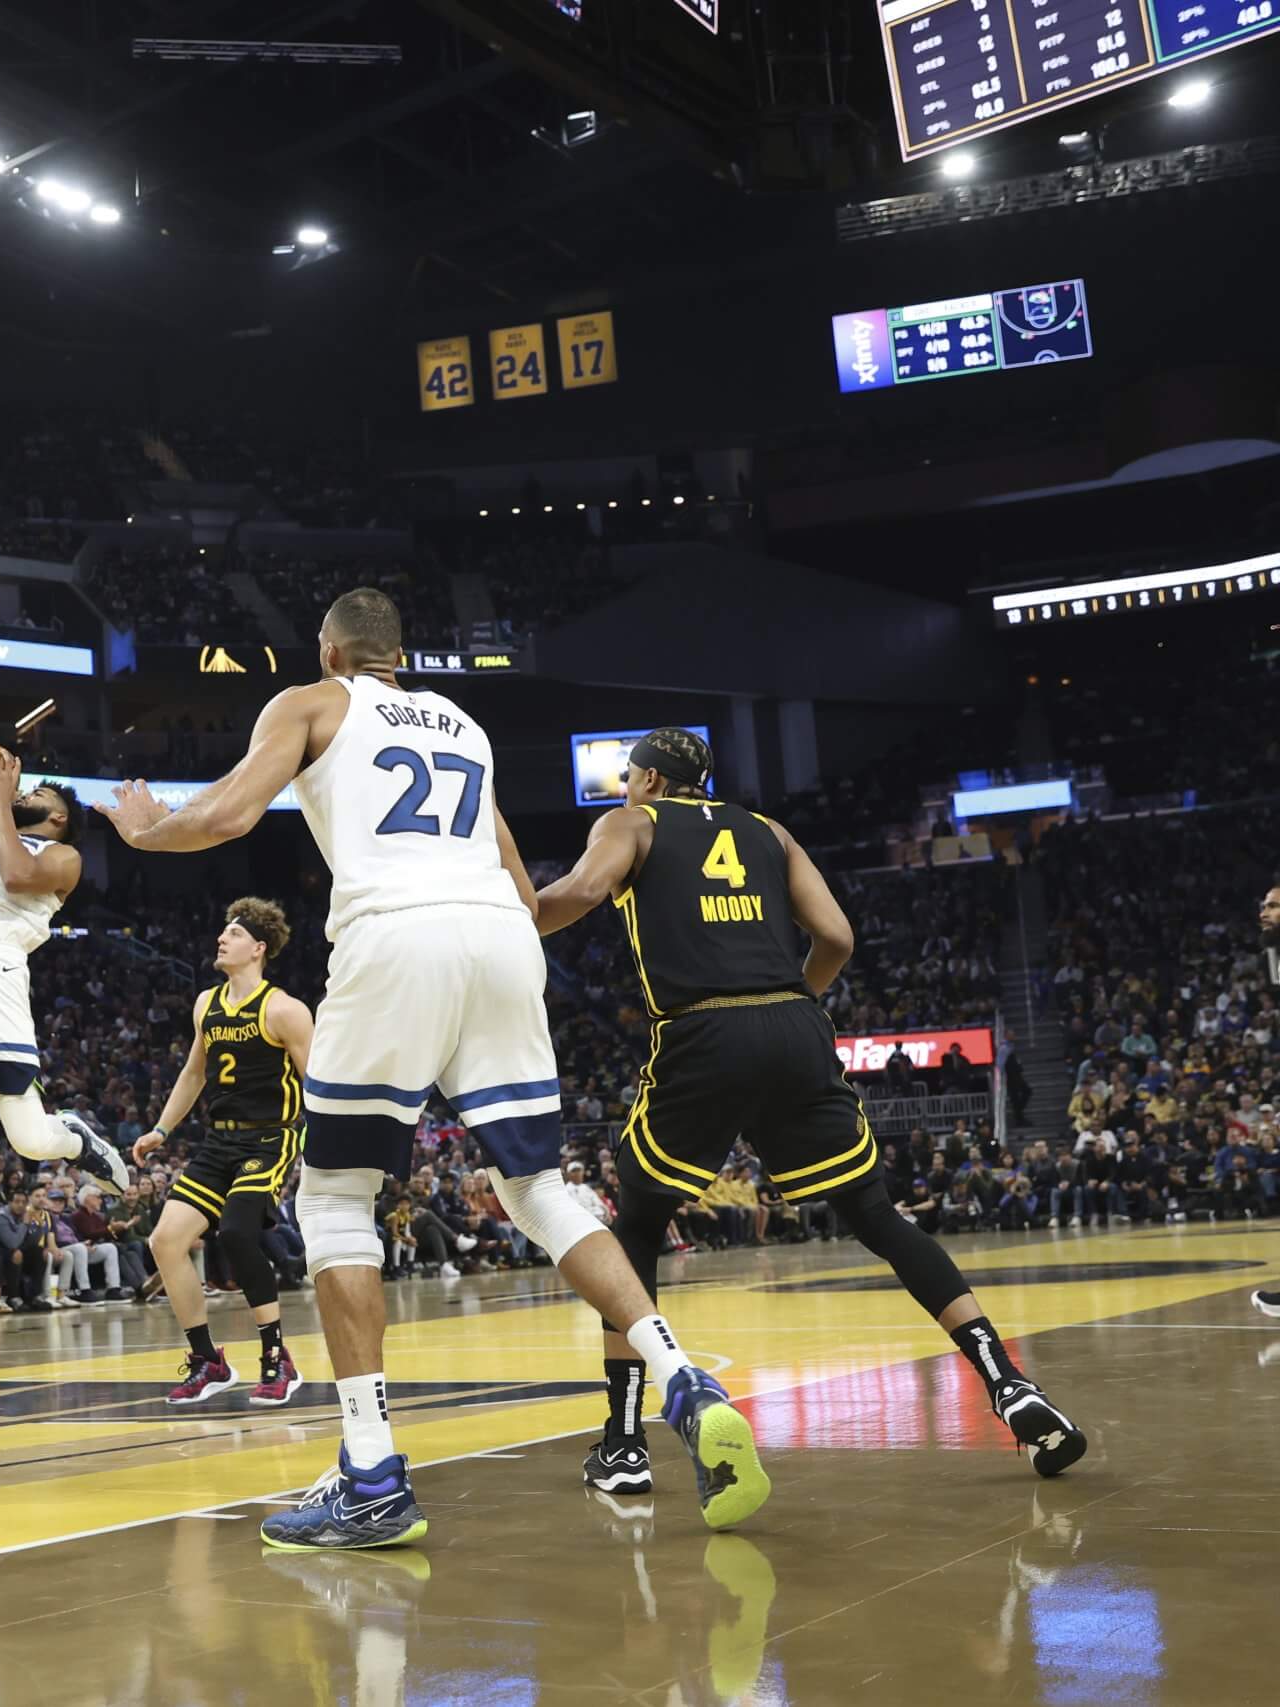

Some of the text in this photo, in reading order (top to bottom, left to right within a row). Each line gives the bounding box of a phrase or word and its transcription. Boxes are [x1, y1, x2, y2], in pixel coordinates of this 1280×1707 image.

[570, 340, 604, 379] 17
[852, 318, 880, 384] xfinity
[425, 362, 469, 400] 42
[495, 351, 542, 390] 24
[474, 655, 511, 668] FINAL
[375, 704, 466, 739] GOBERT
[373, 746, 485, 839] 27
[701, 829, 746, 888] 4
[700, 895, 764, 922] MOODY
[210, 1022, 259, 1042] FRANCISCO
[219, 1052, 236, 1084] 2
